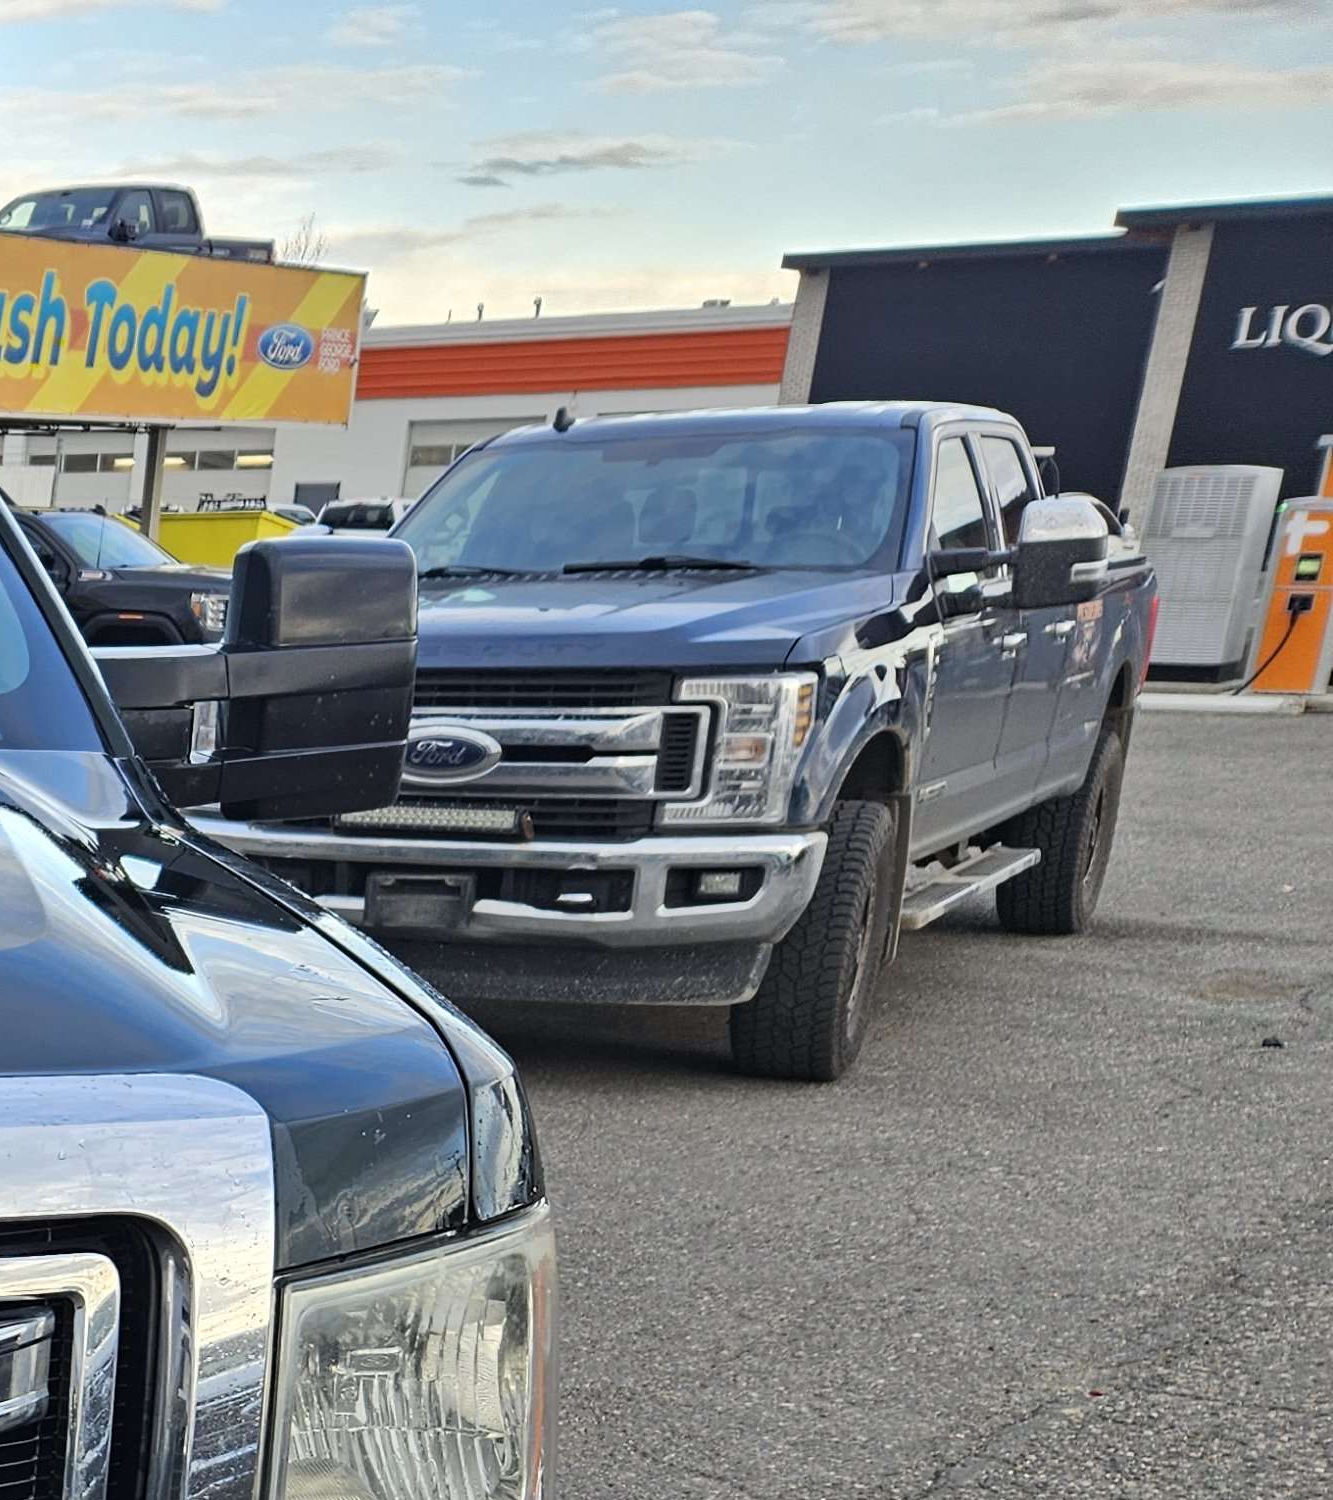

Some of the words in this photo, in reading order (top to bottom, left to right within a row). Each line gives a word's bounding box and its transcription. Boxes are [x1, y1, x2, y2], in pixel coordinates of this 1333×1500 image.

[84, 279, 248, 398] Today!
[266, 328, 306, 362] Ford
[409, 740, 466, 765] Ford
